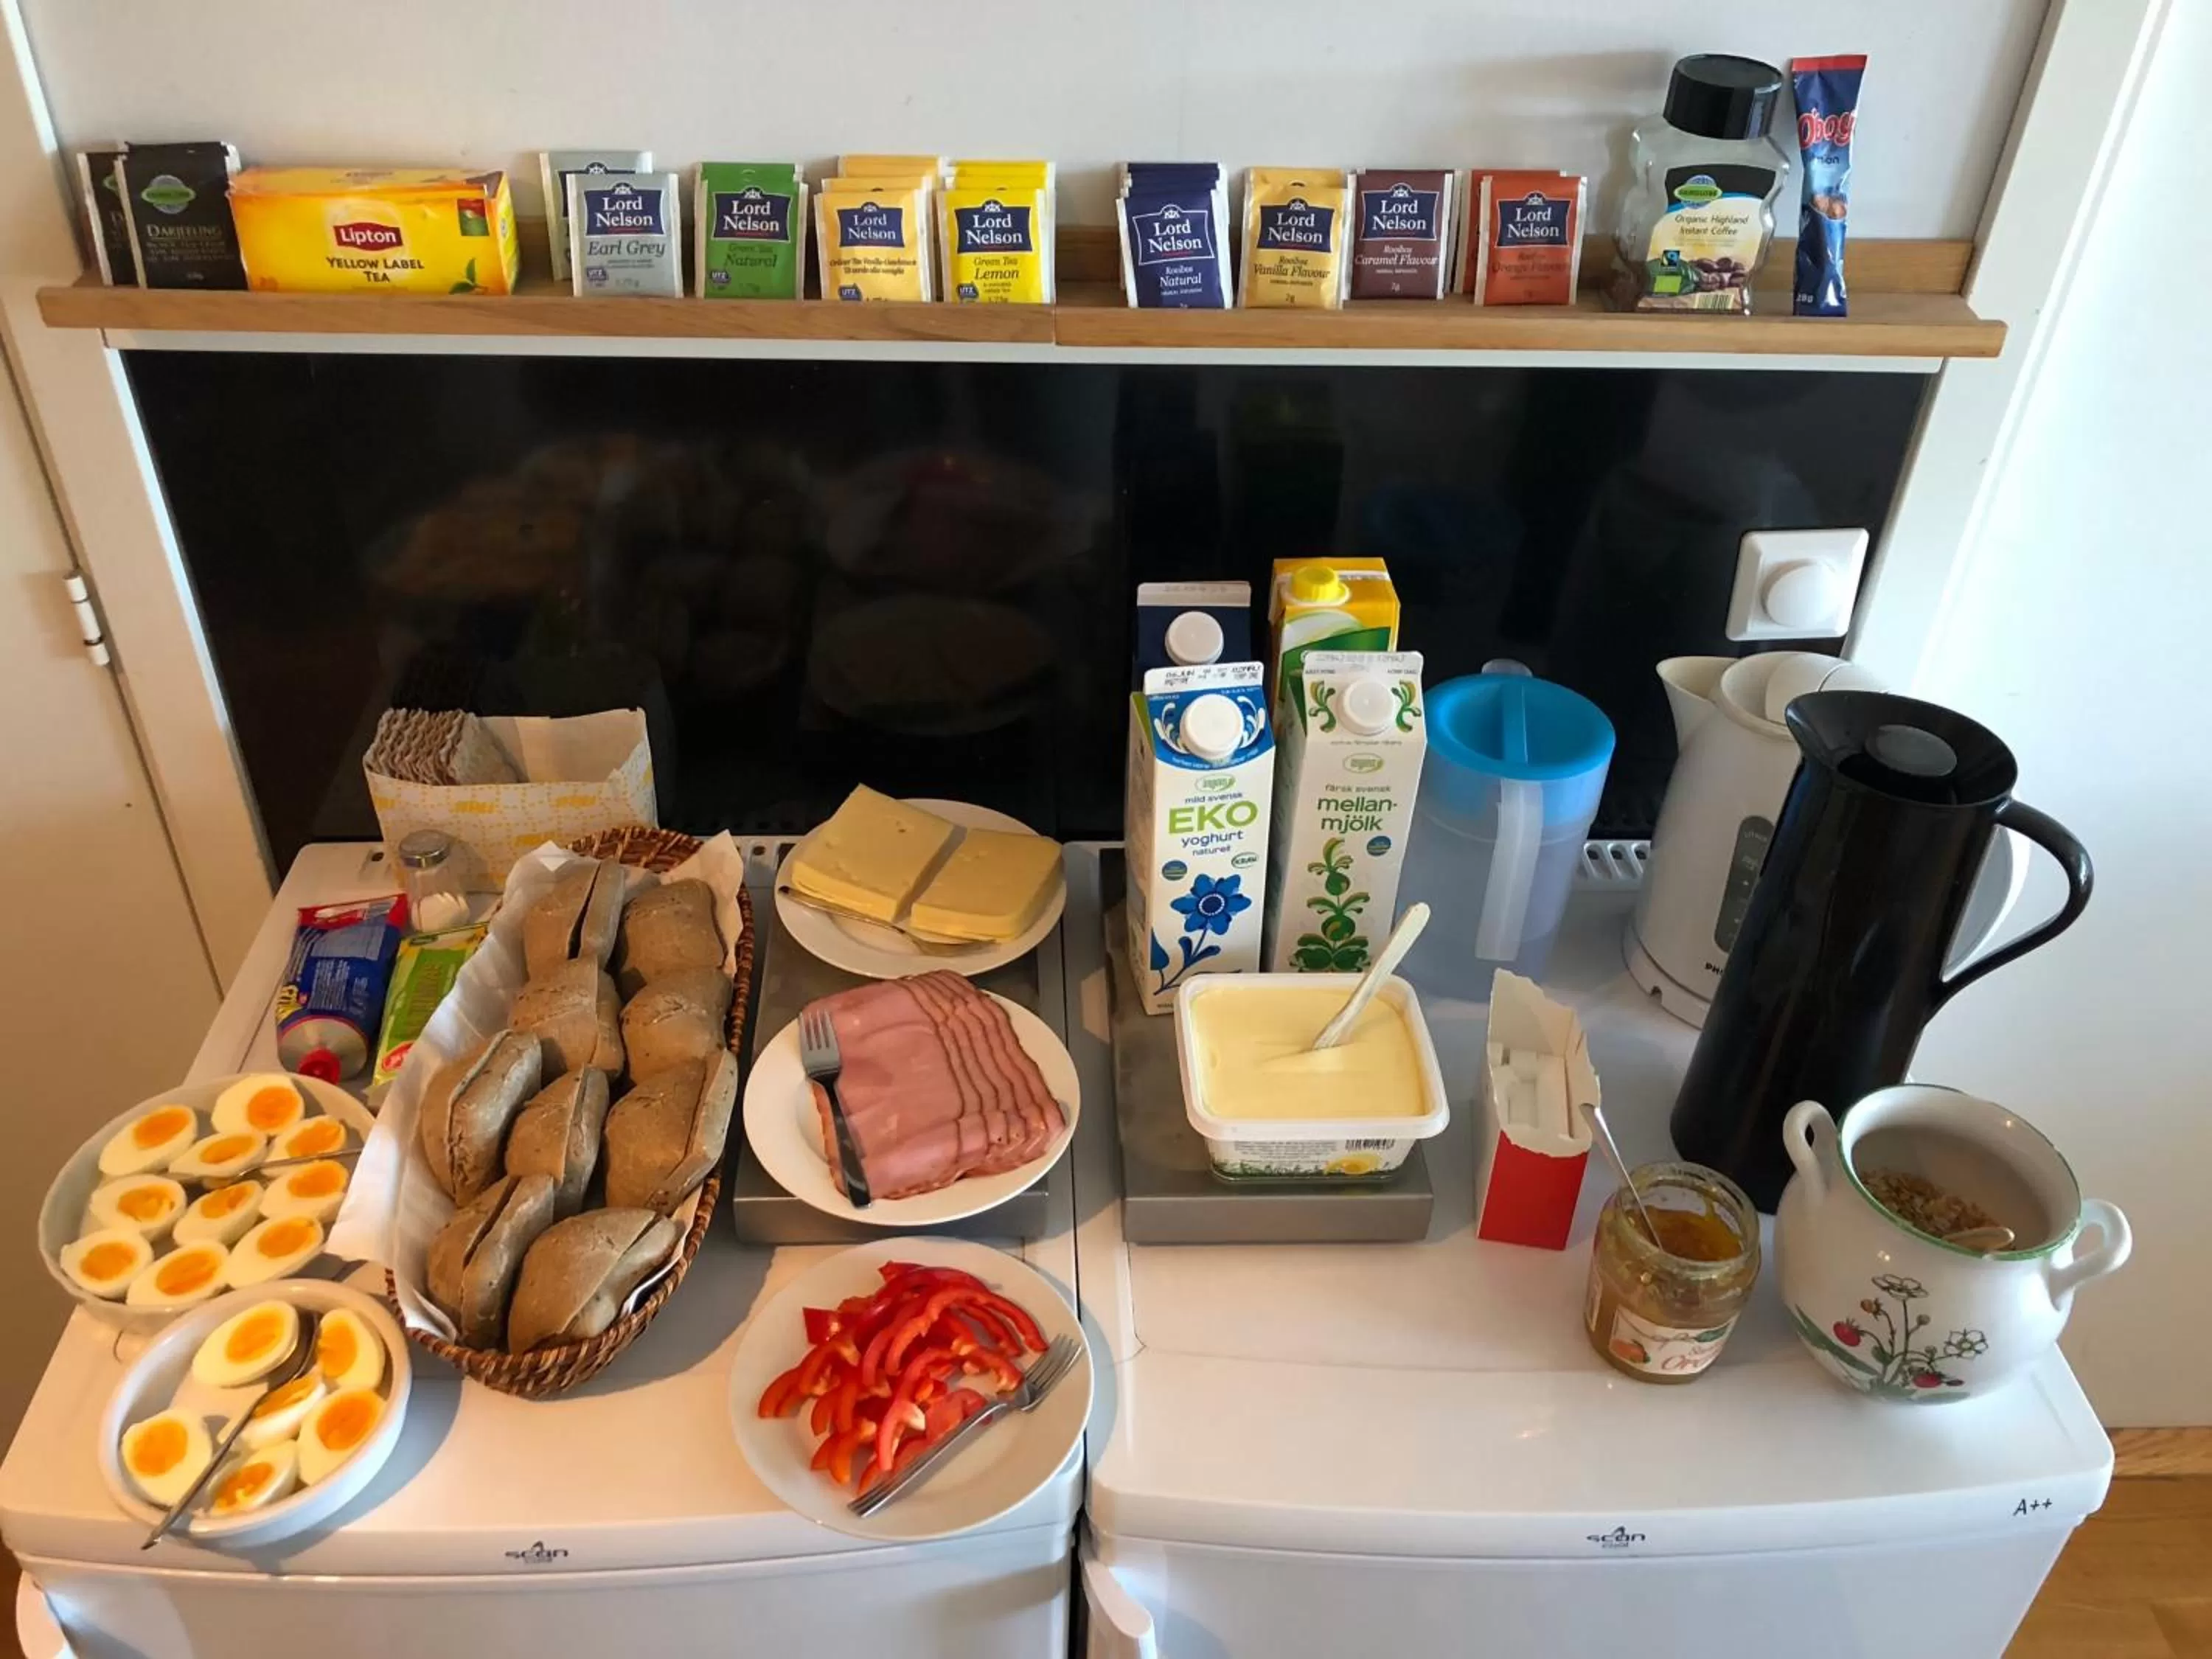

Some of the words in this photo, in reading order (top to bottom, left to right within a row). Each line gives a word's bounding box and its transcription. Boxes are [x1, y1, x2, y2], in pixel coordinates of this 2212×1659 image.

[603, 197, 642, 212] Lord
[731, 201, 771, 215] Lord
[1380, 200, 1418, 214] Lord
[596, 213, 653, 227] Nelson
[853, 215, 887, 226] Lord
[973, 215, 1012, 228] Lord
[1276, 212, 1315, 227] Lord
[1515, 207, 1551, 222] Lord
[1711, 214, 1749, 225] Highland
[723, 217, 779, 232] Nelson
[1153, 220, 1192, 236] Lord
[1372, 215, 1427, 230] Nelson
[1711, 225, 1739, 235] Coffee
[340, 228, 397, 245] Lipton
[848, 227, 896, 240] Nelson
[965, 230, 1023, 245] Nelson
[1267, 227, 1323, 243] Nelson
[1507, 223, 1559, 238] Nelson
[587, 239, 622, 256] Earl
[626, 240, 667, 257] Grey
[1148, 237, 1203, 253] Nelson
[326, 257, 379, 271] YELLOW
[383, 258, 425, 271] LABEL
[724, 254, 779, 268] Natural
[973, 256, 1001, 266] Green
[1003, 256, 1018, 265] Tea
[1354, 254, 1397, 265] Caramel
[1399, 254, 1439, 265] Flavour
[364, 271, 390, 283] TEA
[974, 267, 1019, 280] Lemon
[1253, 262, 1288, 277] Vanilla
[1290, 265, 1330, 279] Flavour
[1159, 271, 1202, 288] Natural
[1354, 784, 1392, 793] svensk
[1184, 795, 1206, 803] mild
[1207, 792, 1243, 801] svensk
[1317, 796, 1398, 813] mellan-
[1169, 800, 1259, 834] EKO
[1321, 814, 1382, 834] mjölk
[1181, 830, 1245, 849] yoghurt
[2013, 1497, 2053, 1517] A++
[1585, 1526, 1646, 1543] scan
